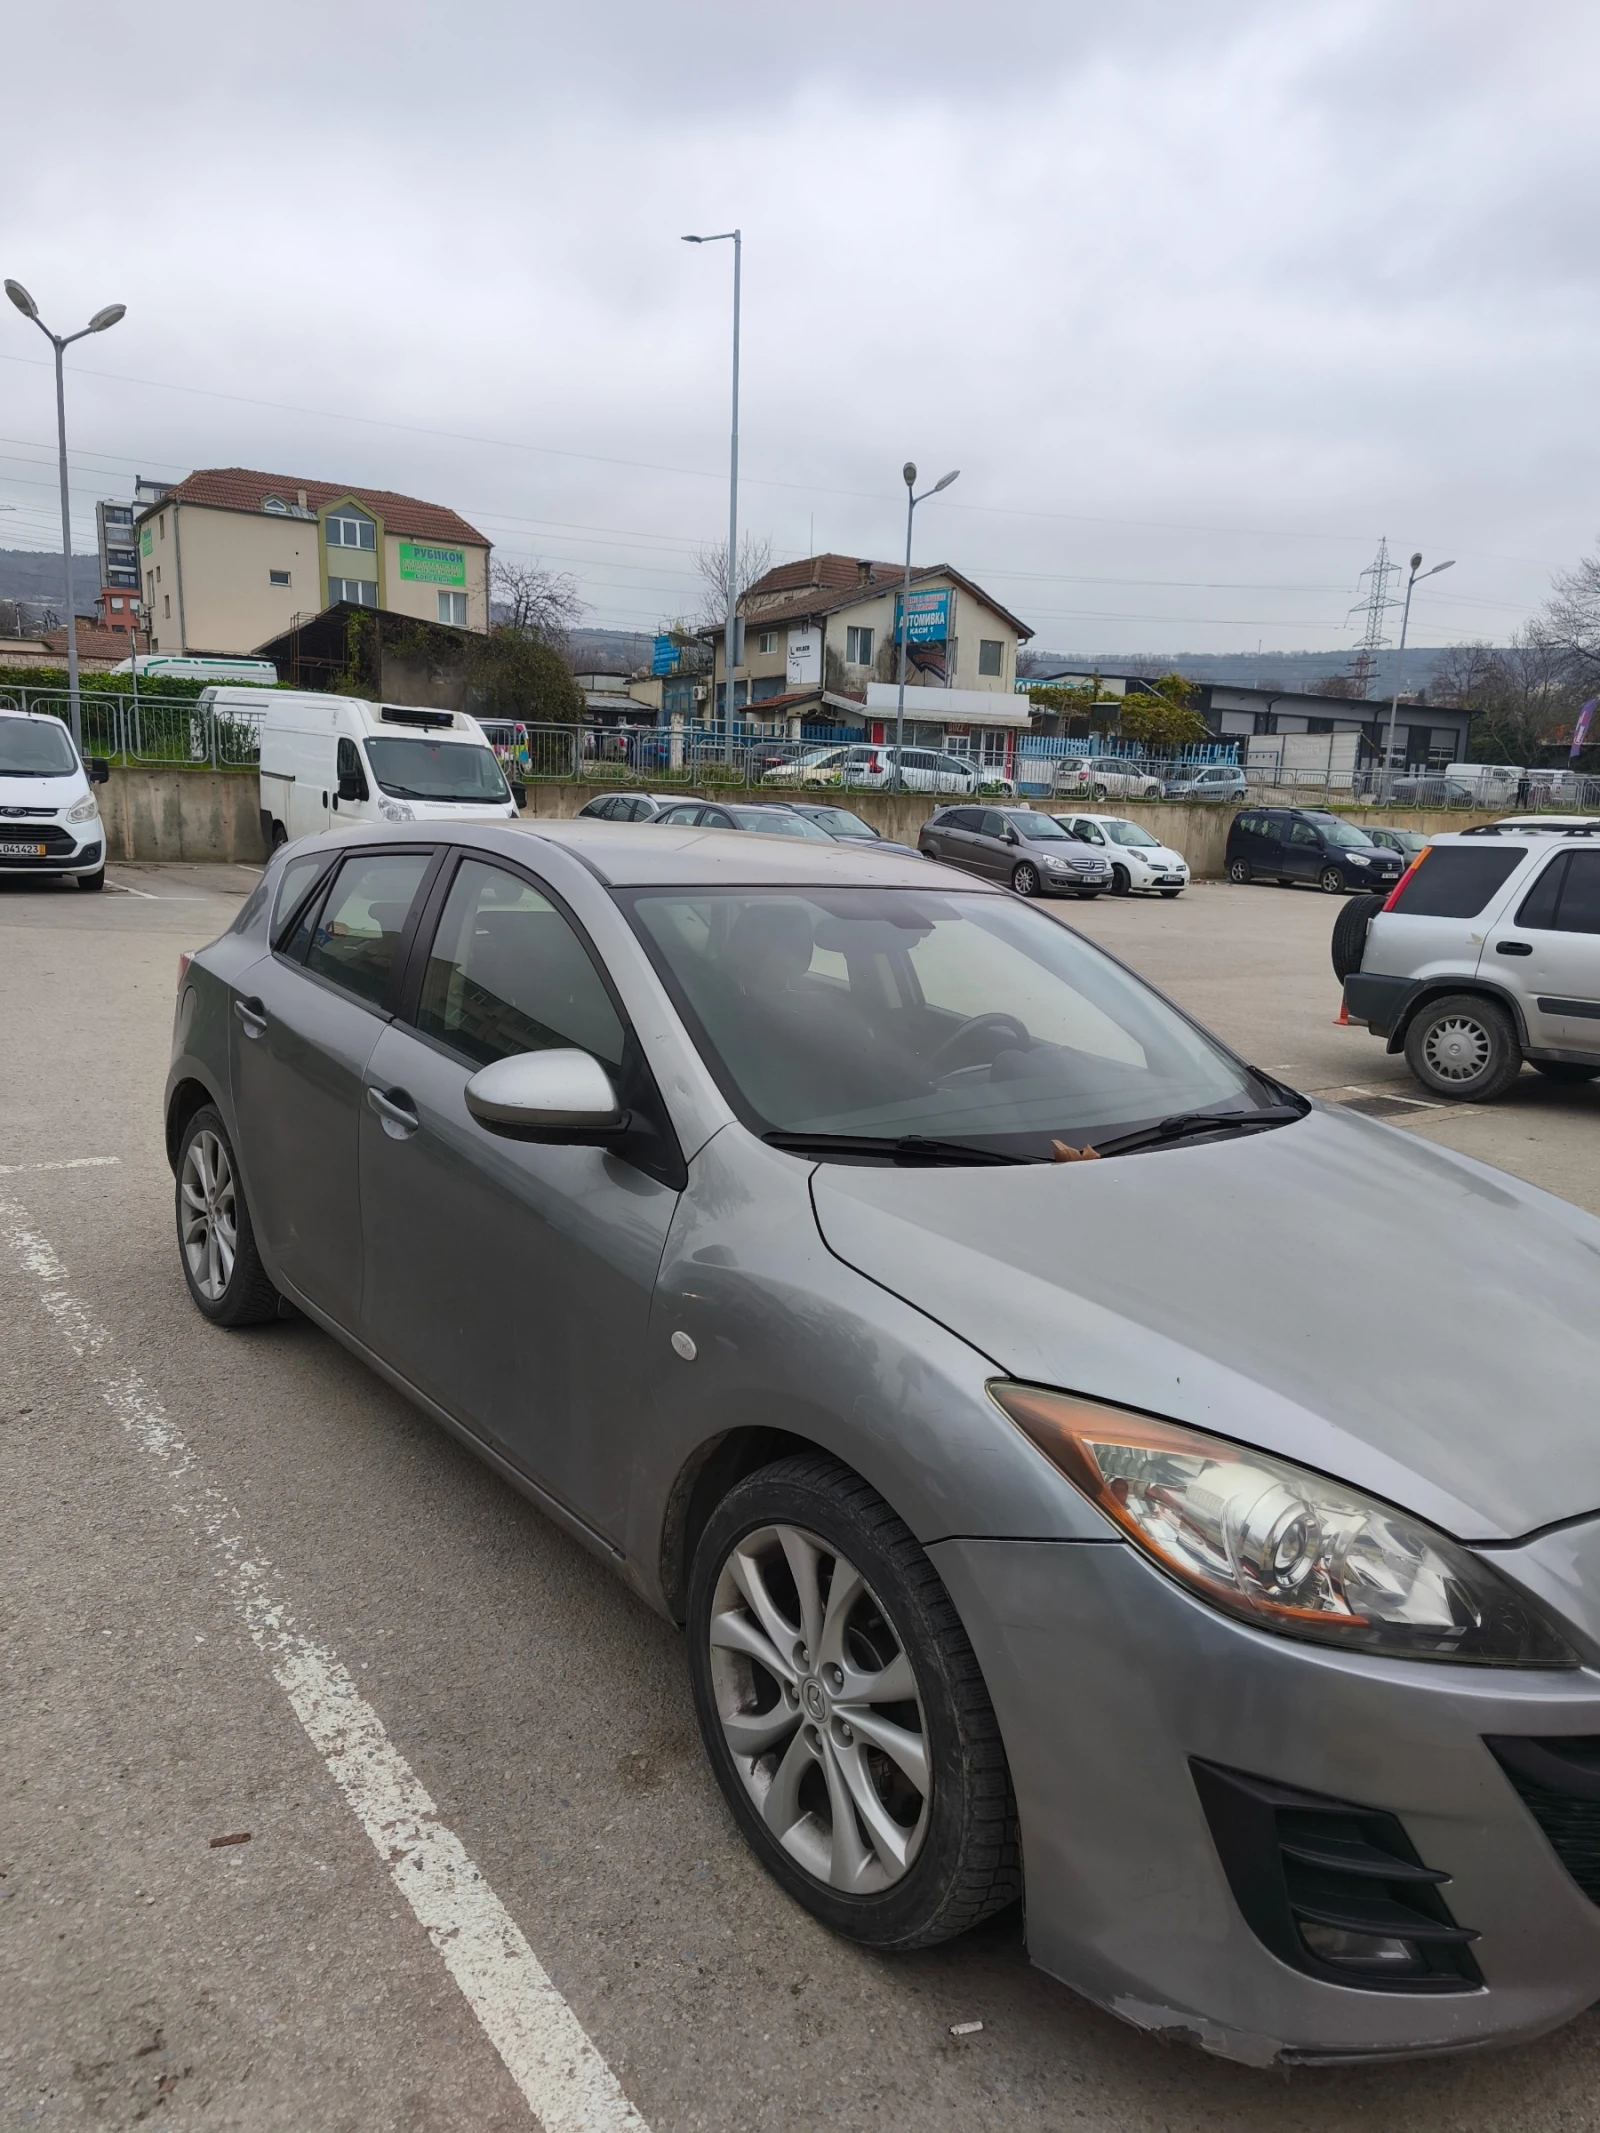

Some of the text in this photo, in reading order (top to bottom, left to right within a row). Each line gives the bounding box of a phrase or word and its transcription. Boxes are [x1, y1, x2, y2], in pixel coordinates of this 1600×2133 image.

[413, 547, 463, 563] РУБИКОН
[898, 612, 945, 628] АТОМИВКА
[910, 626, 928, 634] КАСИ
